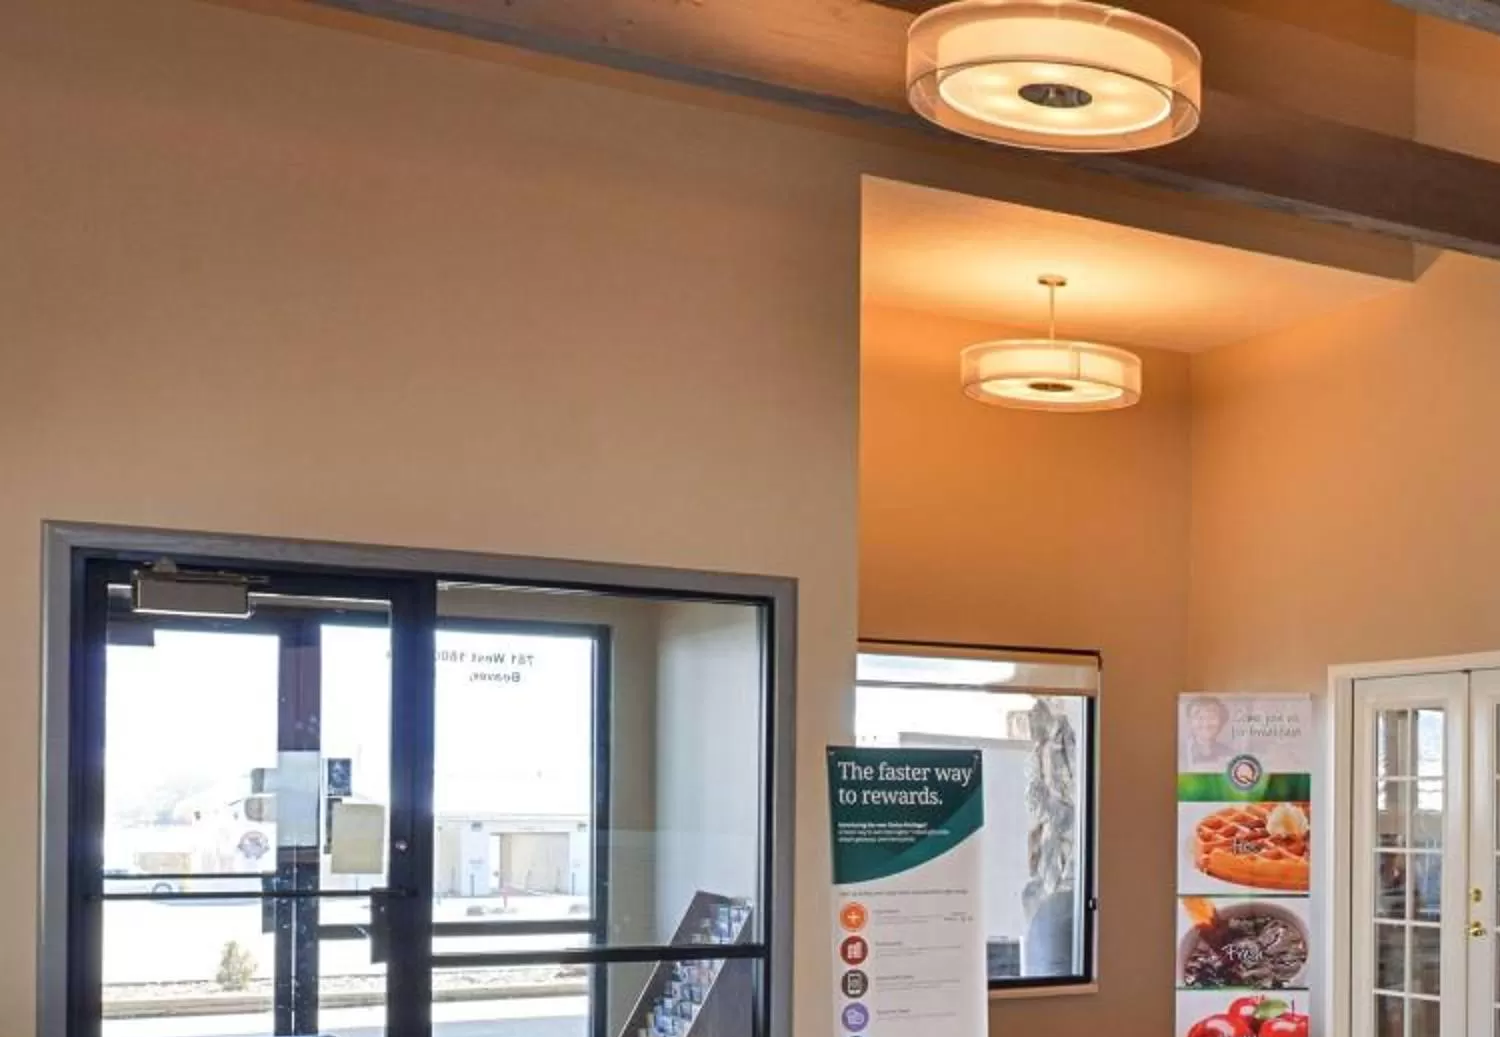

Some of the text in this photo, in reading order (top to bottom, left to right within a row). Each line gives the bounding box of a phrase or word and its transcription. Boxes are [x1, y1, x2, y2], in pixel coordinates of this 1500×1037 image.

[837, 761, 973, 787] The faster way
[838, 786, 943, 806] to rewards.
